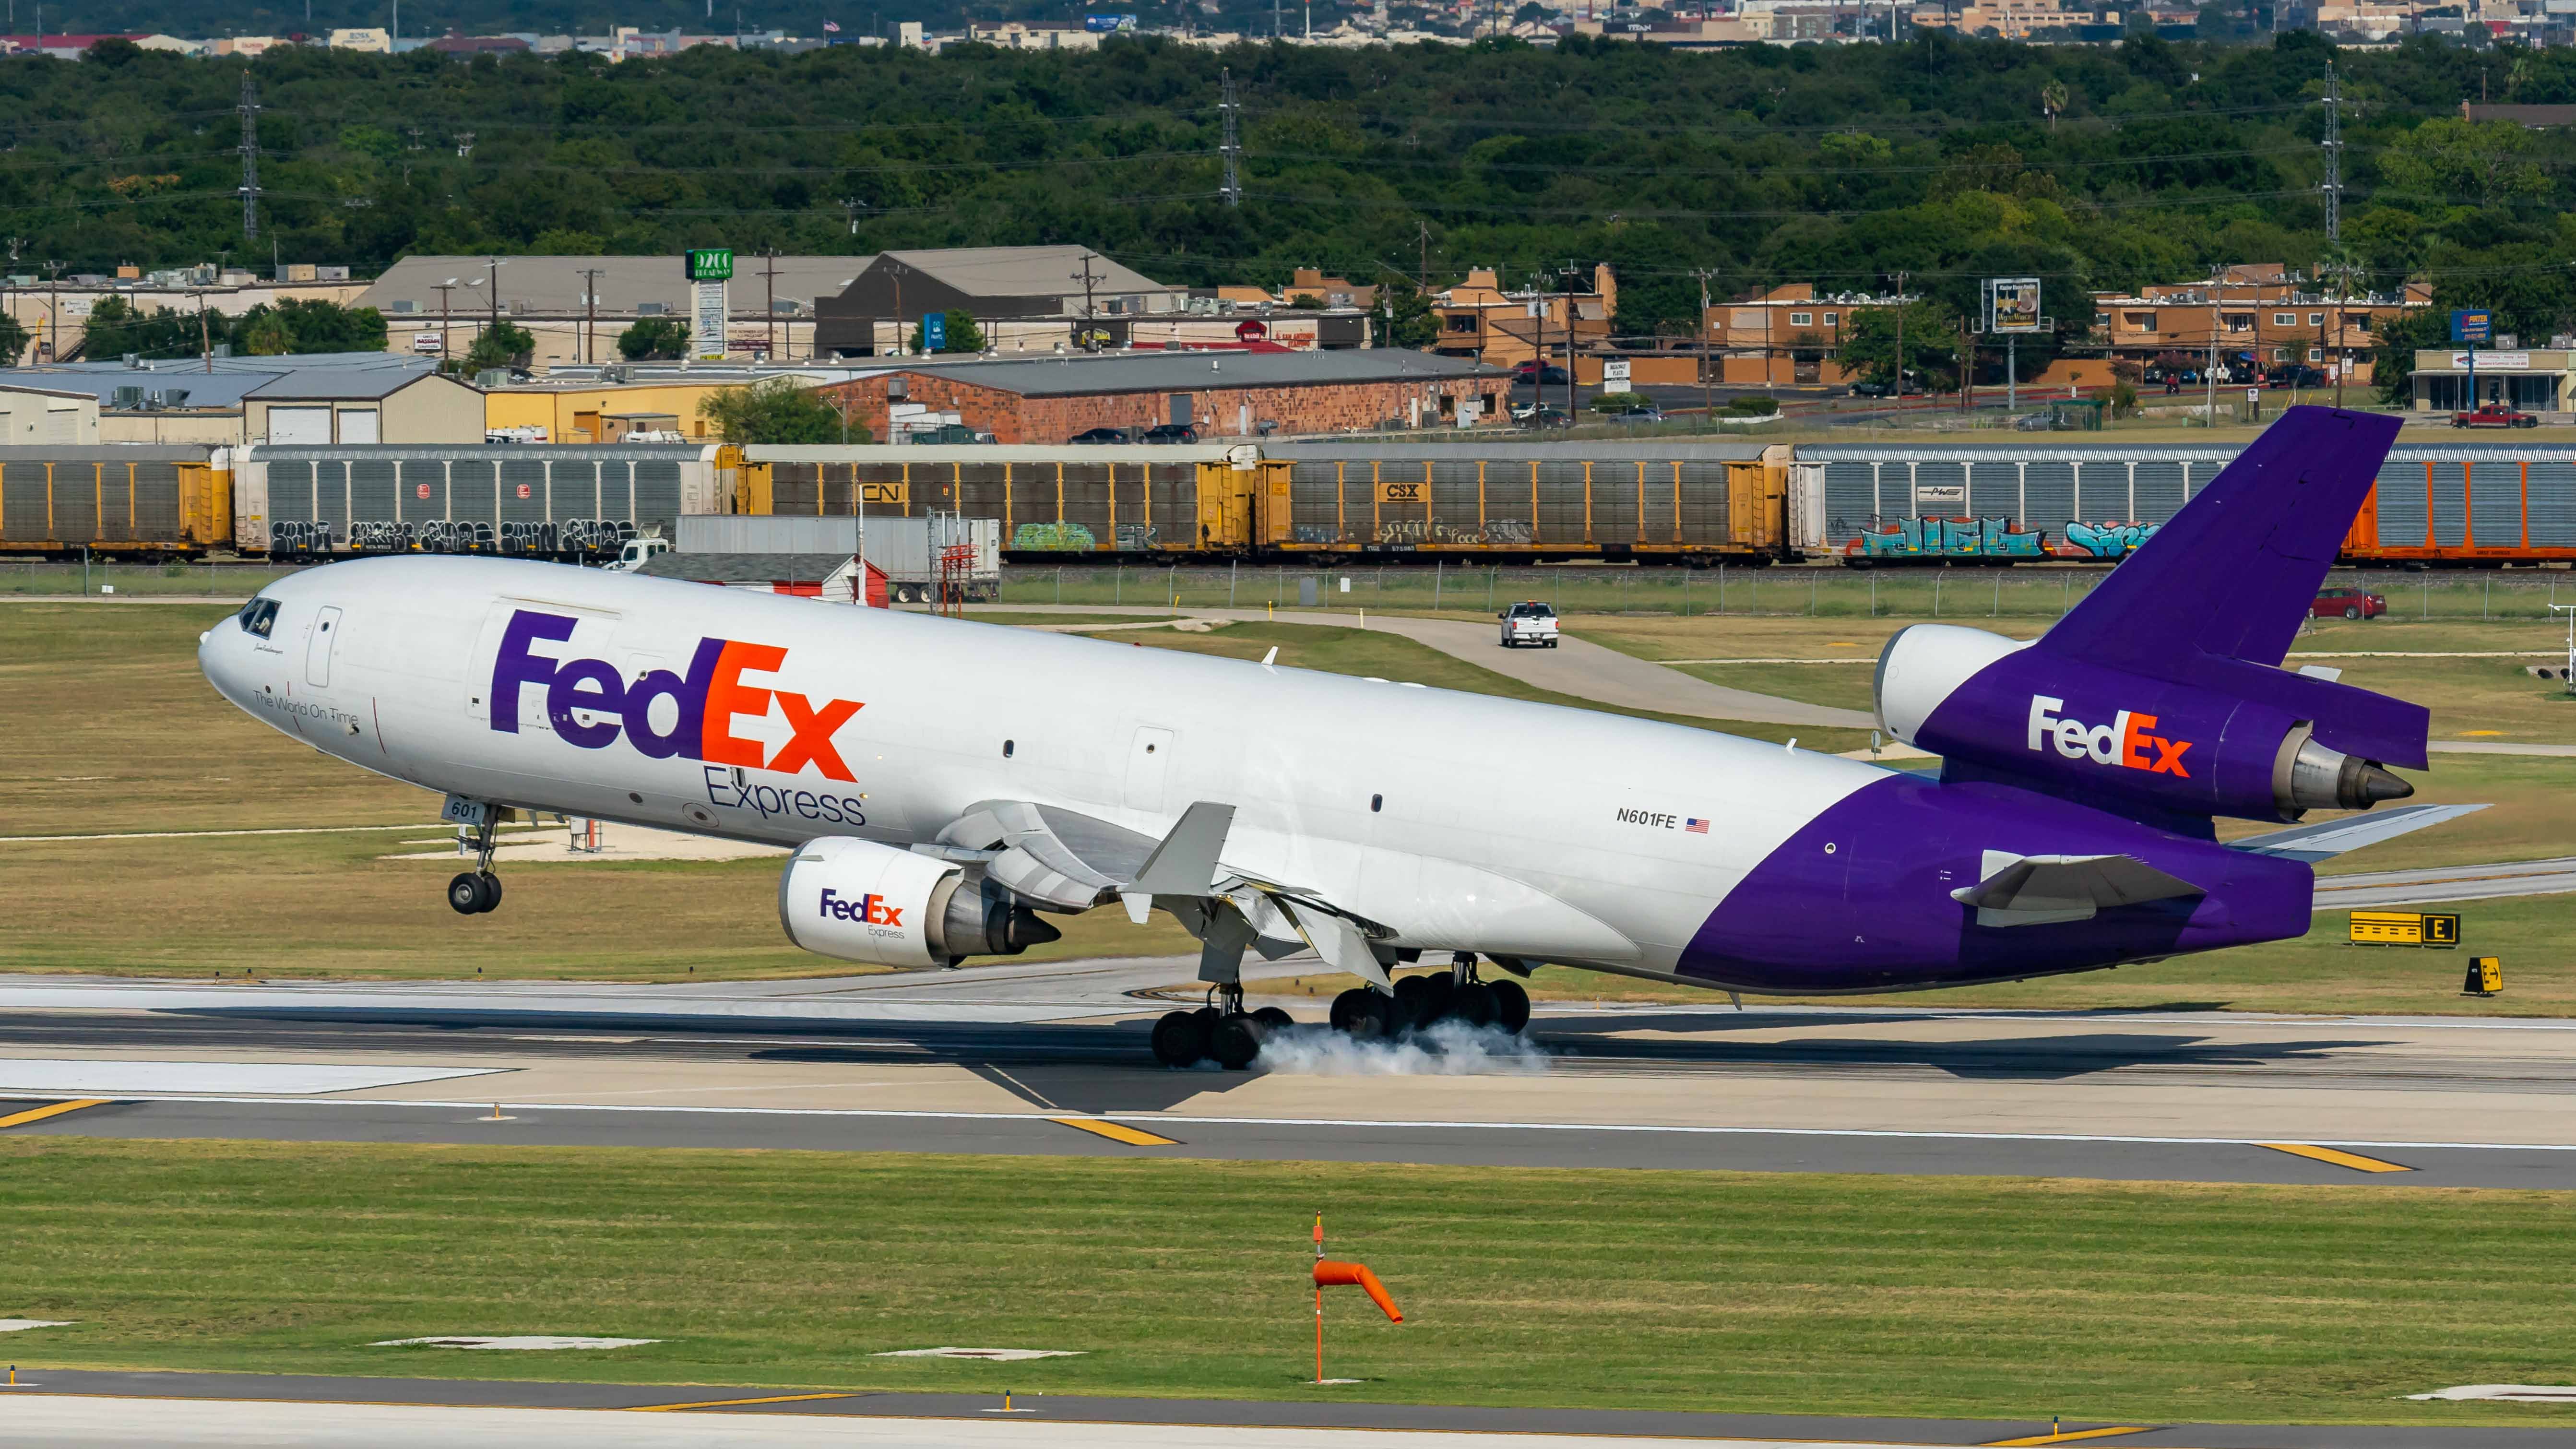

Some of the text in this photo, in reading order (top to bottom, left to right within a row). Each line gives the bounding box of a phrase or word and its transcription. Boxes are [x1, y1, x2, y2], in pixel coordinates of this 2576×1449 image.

[696, 253, 730, 269] 9200
[862, 485, 899, 501] CN
[1387, 484, 1419, 497] CSX
[490, 608, 866, 783] FedEx
[253, 690, 358, 725] The World On Time
[2028, 694, 2193, 778] FedEx
[704, 765, 866, 826] Express
[451, 802, 477, 819] 601
[1616, 808, 1677, 829] N601FE
[820, 888, 903, 927] FedEx
[867, 925, 904, 939] Express
[2434, 919, 2445, 938] E
[2482, 965, 2490, 984] E
